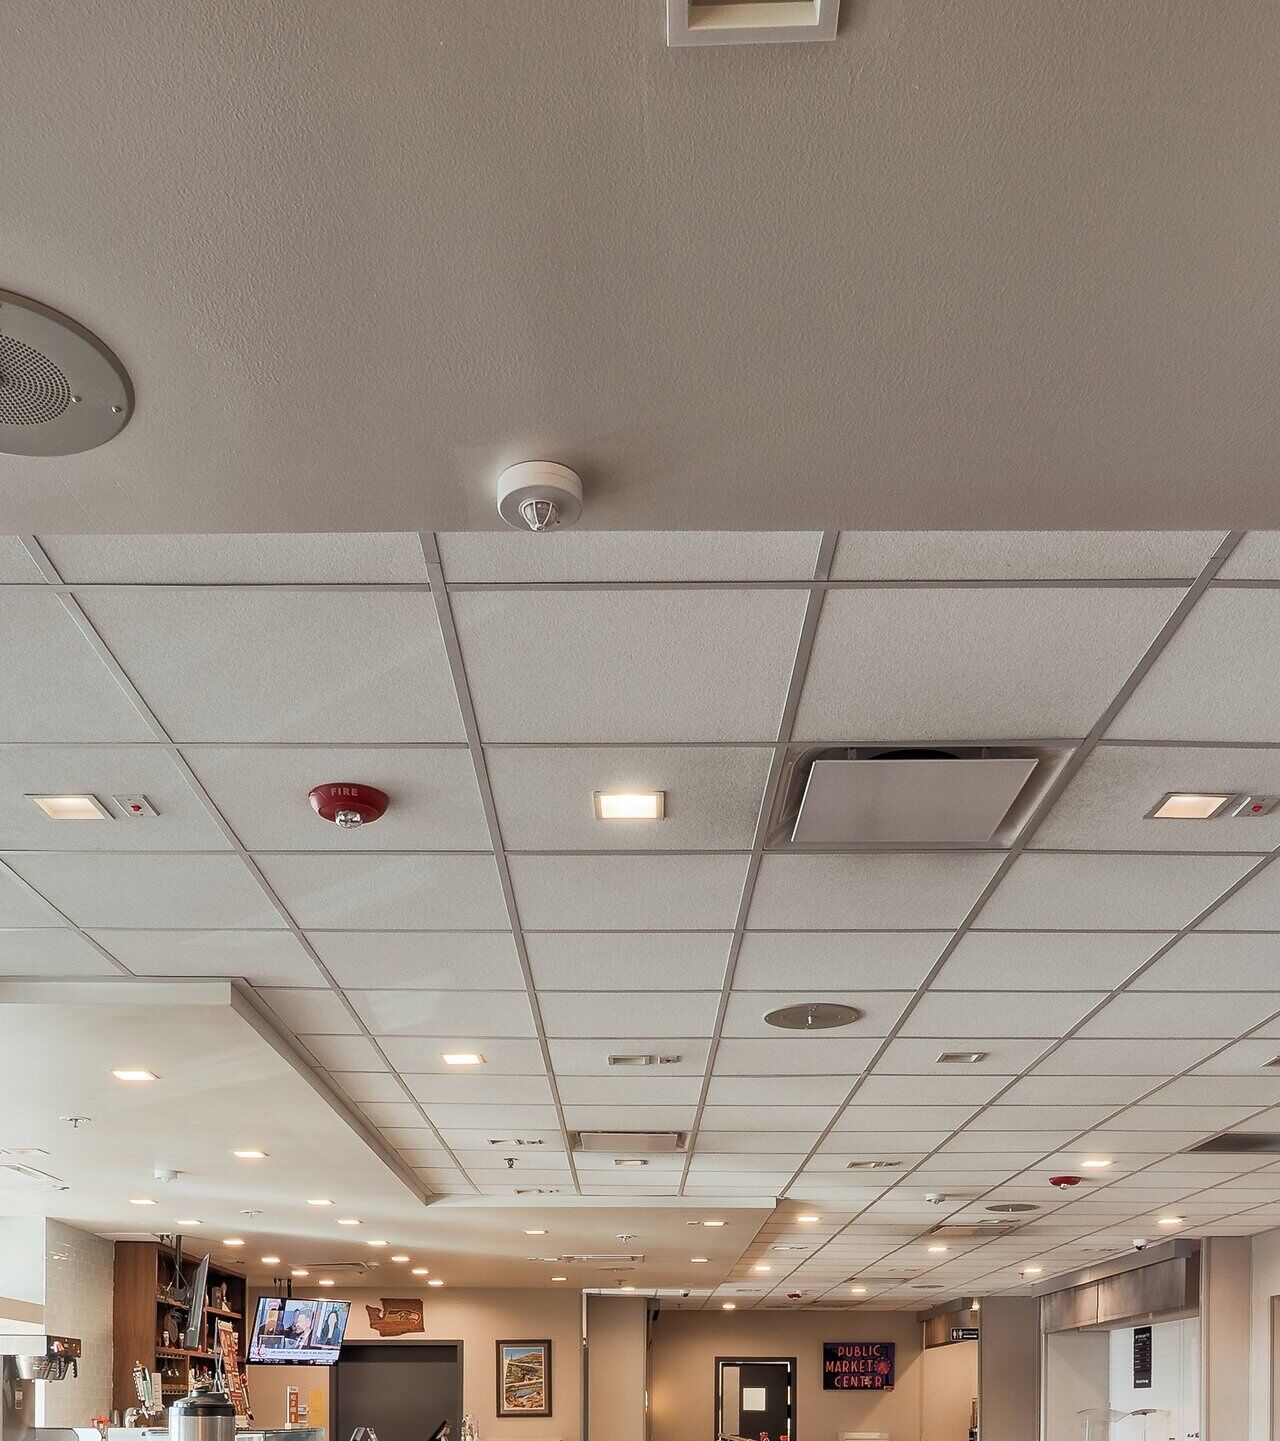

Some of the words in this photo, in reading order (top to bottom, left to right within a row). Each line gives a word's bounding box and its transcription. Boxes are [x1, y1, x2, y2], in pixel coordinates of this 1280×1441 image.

[330, 787, 359, 797] FIRE
[837, 1344, 881, 1357] PUBLIC
[825, 1360, 874, 1373] MARKET
[834, 1375, 882, 1388] CENTER
